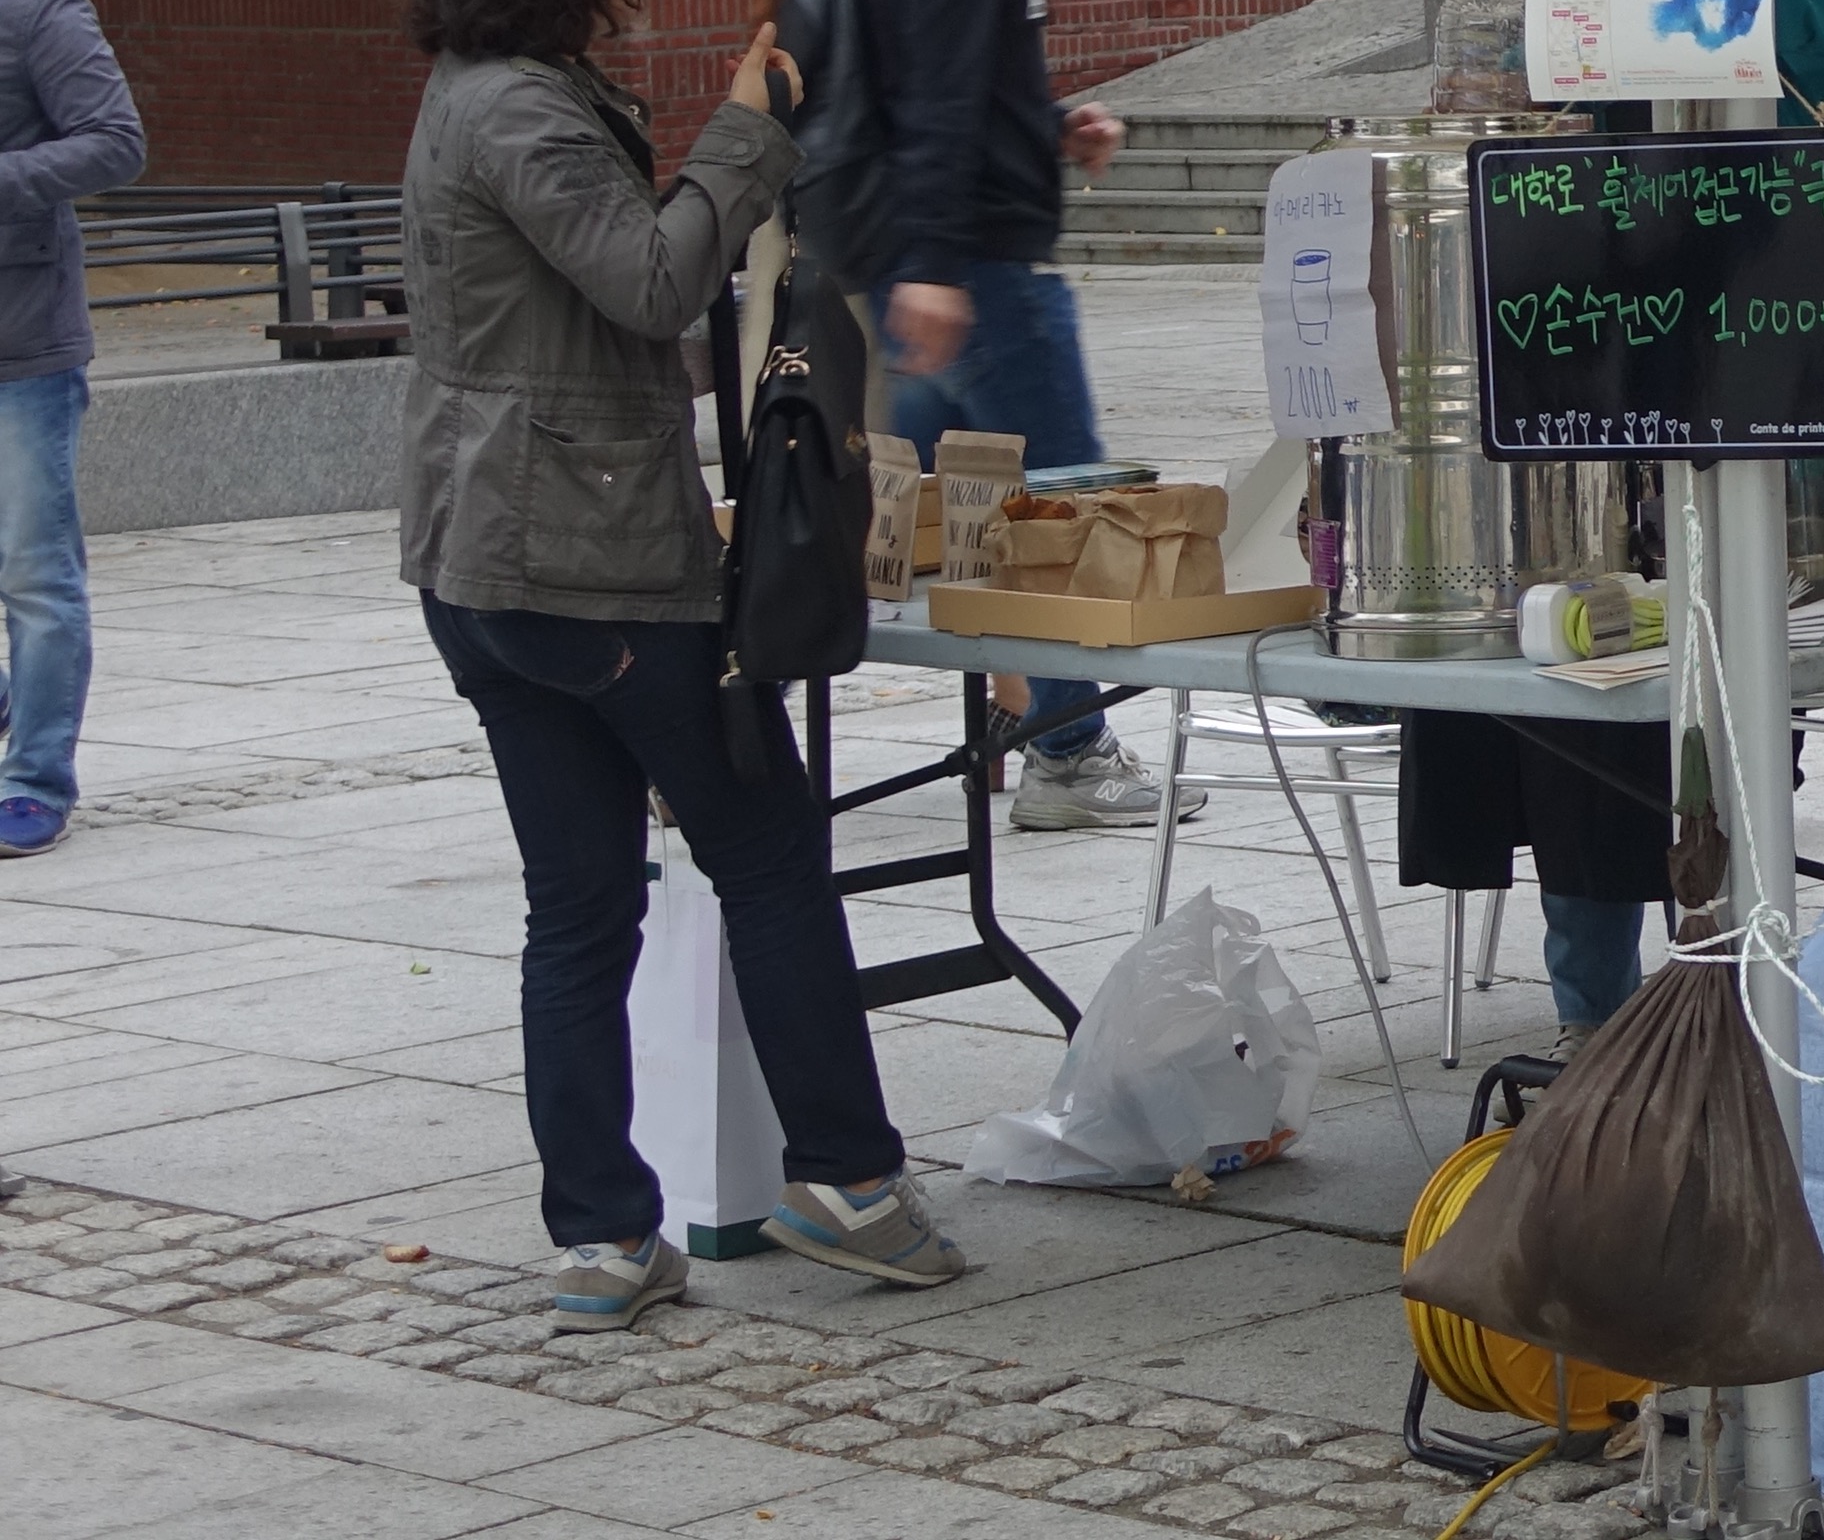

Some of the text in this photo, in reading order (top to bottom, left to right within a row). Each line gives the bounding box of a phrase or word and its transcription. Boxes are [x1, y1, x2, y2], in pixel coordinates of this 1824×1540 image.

[1491, 163, 1584, 218] 대학로
[1274, 192, 1346, 225] 아메리카노
[1545, 282, 1654, 355] 손수건
[1750, 423, 1779, 434] Conte
[1781, 422, 1795, 434] de
[947, 479, 995, 507] TANZANIA
